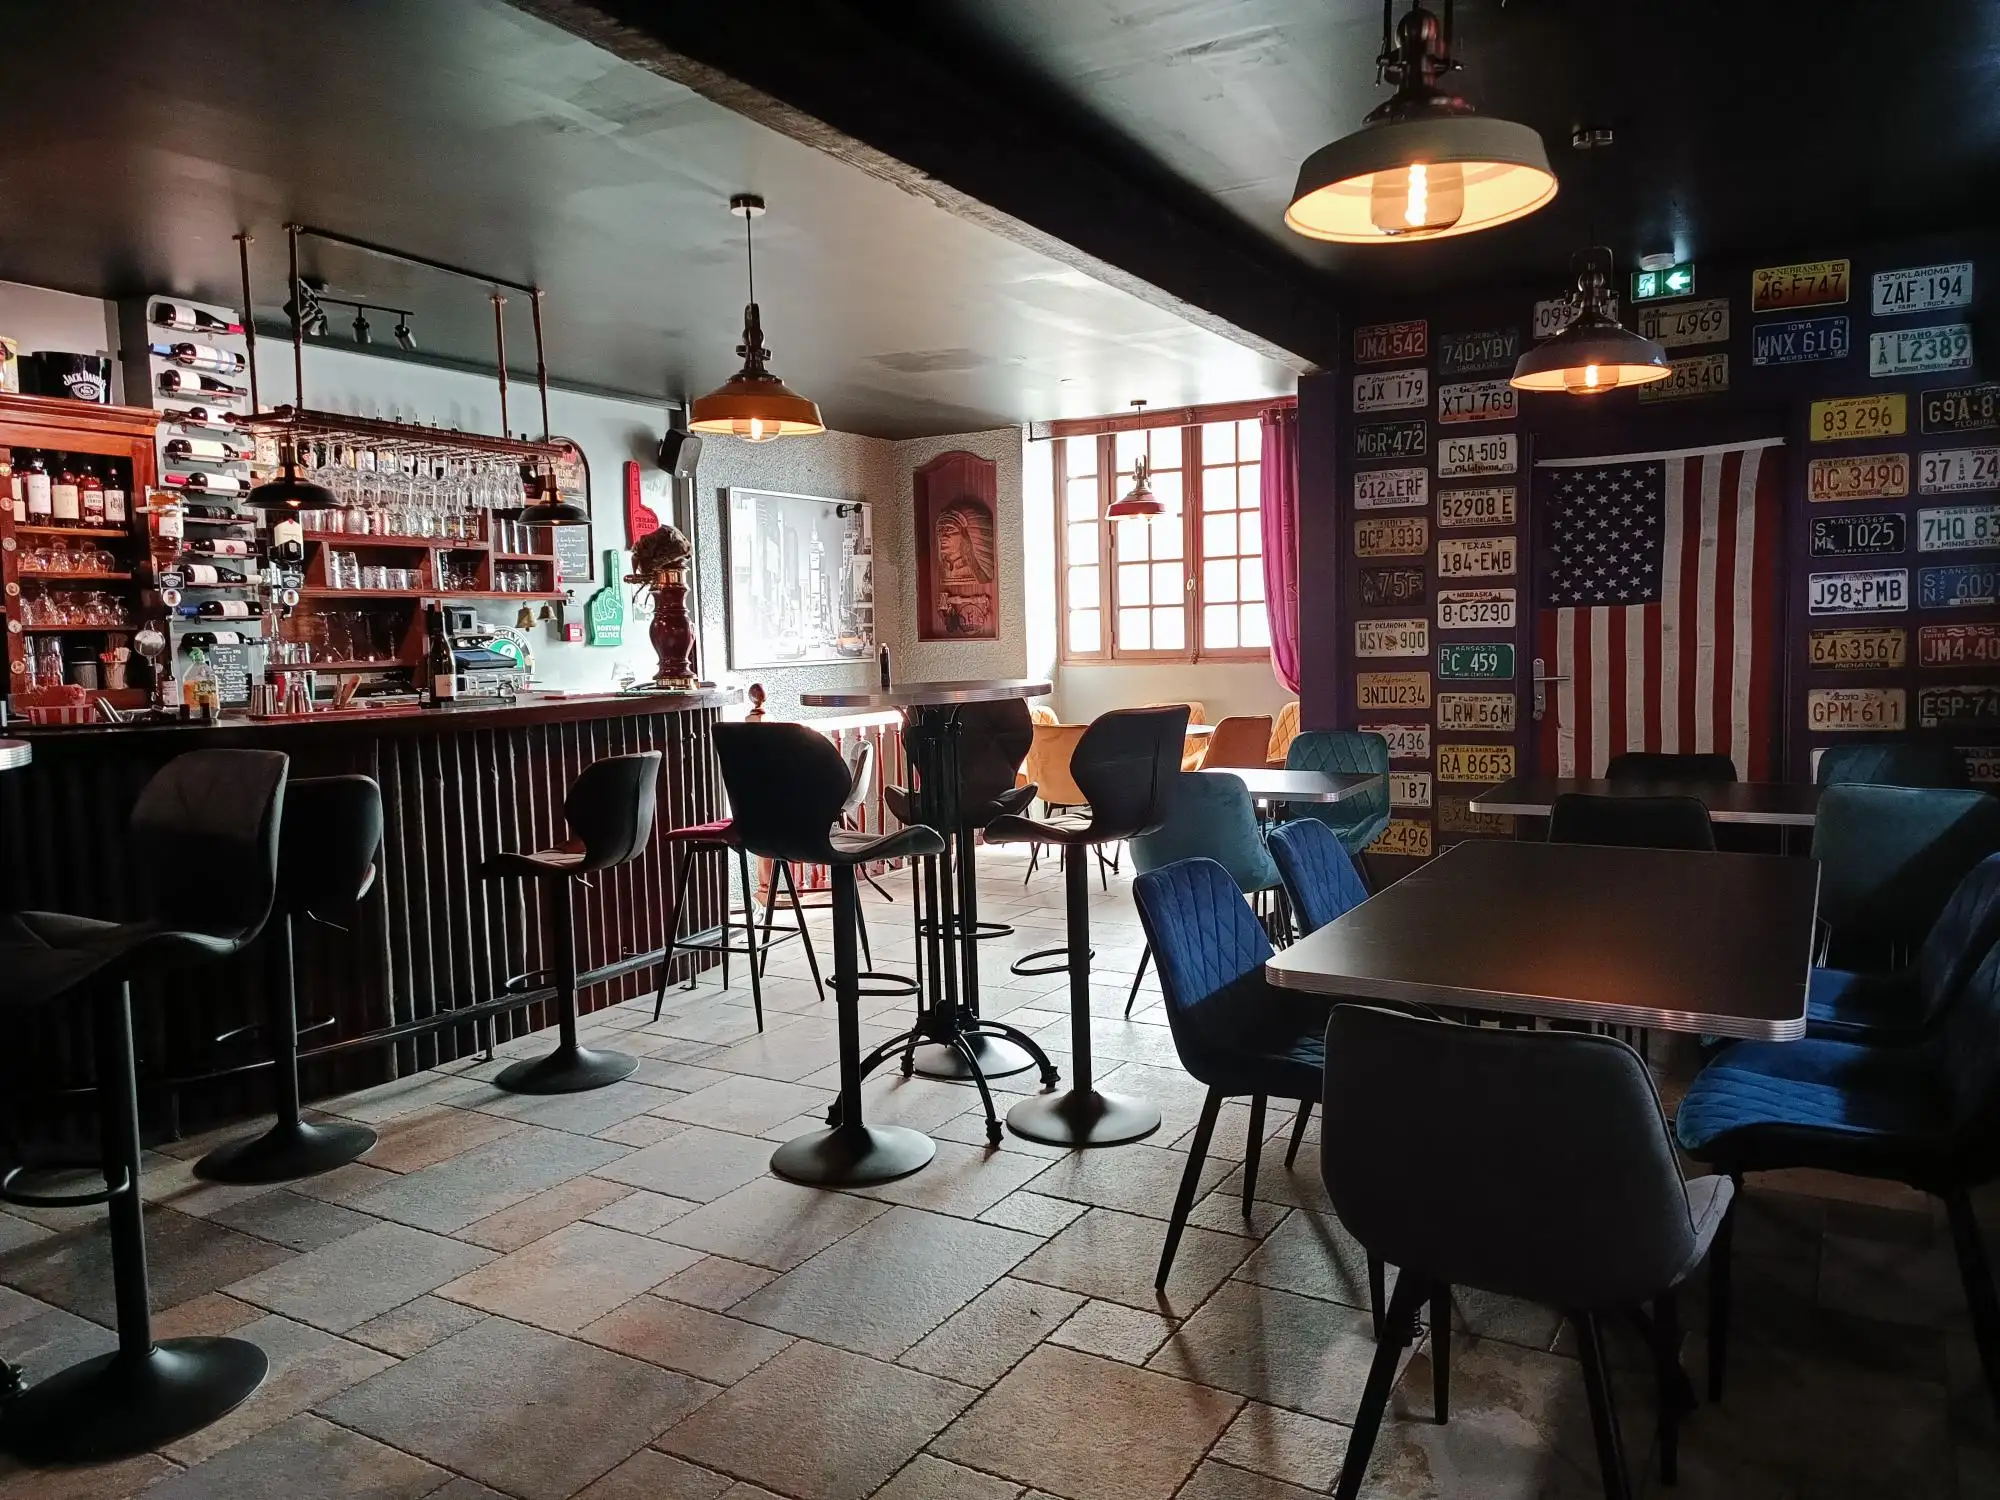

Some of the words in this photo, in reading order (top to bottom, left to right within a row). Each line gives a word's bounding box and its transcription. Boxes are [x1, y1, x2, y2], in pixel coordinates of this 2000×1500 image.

[1894, 267, 1951, 280] OKLAHOMA
[1676, 311, 1722, 335] 4969
[1787, 322, 1812, 331] IOWA
[1757, 333, 1796, 357] WNX
[1804, 328, 1843, 353] 616
[1897, 330, 1932, 342] IDAHO
[62, 372, 83, 386] JACK
[1357, 382, 1385, 402] CJX
[1397, 380, 1424, 399] 179
[1823, 410, 1847, 432] 83
[1855, 407, 1892, 430] 296
[1954, 418, 1997, 428] FLORIDA
[1812, 467, 1840, 492] WC
[1849, 464, 1904, 489] 3490
[1925, 459, 1952, 484] 37
[1359, 480, 1386, 499] 612
[1396, 475, 1424, 497] ERF
[1943, 481, 1997, 490] NEBRASKA
[1442, 497, 1495, 518] 52908
[1502, 495, 1512, 515] E
[1830, 516, 1872, 526] KANSAS
[1923, 517, 1966, 542] 7HQ
[1848, 523, 1894, 547] 1025
[1941, 538, 1997, 548] MINNESOTA
[1461, 542, 1493, 550] TEXAS
[1842, 573, 1874, 582] TEXAS
[1814, 583, 1852, 605] J98
[1862, 580, 1902, 603] PMB
[595, 624, 619, 632] BOSTON
[1375, 622, 1407, 630] OKLAHOMA
[1400, 631, 1425, 649] 900
[1469, 653, 1498, 672] 459
[1362, 686, 1425, 705] 3NIU234
[1442, 704, 1473, 723] LRW
[1479, 704, 1510, 723] 56M
[1812, 702, 1898, 723] GPM-611
[1440, 754, 1461, 773] RA
[1467, 754, 1512, 774] 8653
[1401, 782, 1427, 799] 187
